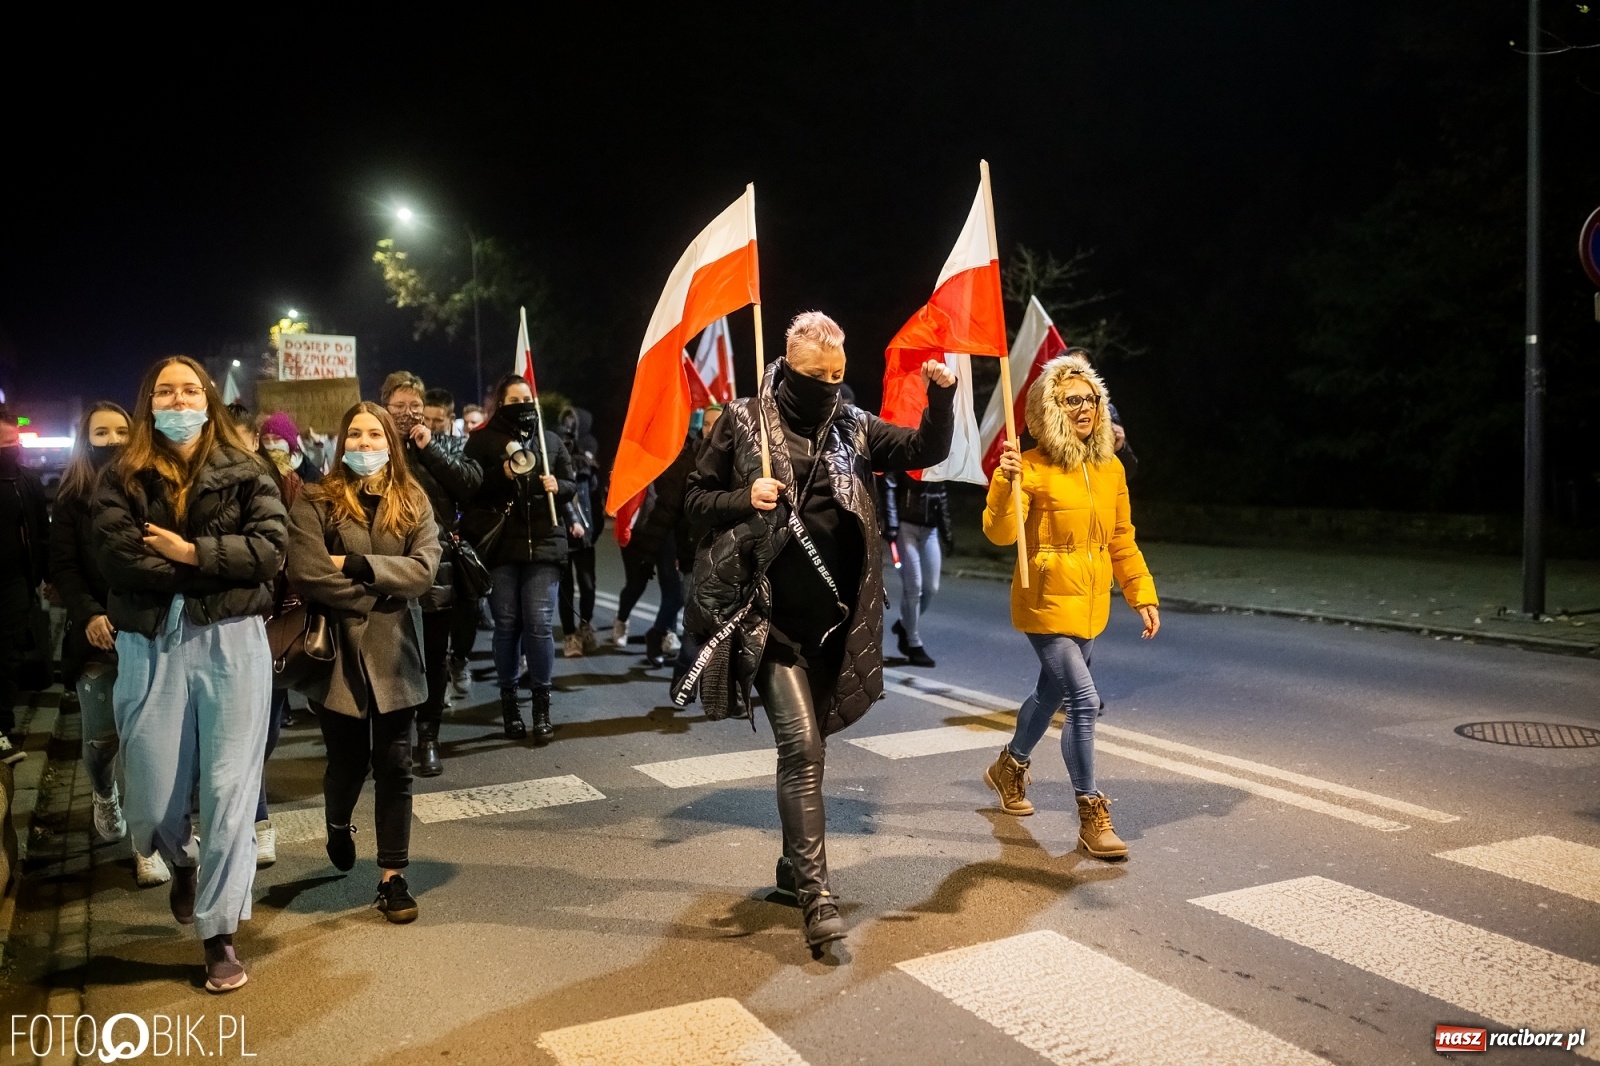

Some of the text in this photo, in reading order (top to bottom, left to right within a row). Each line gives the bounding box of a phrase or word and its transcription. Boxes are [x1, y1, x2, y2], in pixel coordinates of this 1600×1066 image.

[335, 342, 353, 353] DO
[788, 511, 805, 538] IFUL
[800, 536, 817, 557] LIFE
[812, 555, 822, 566] IS
[716, 622, 736, 641] LIFE
[709, 636, 720, 648] IS
[681, 646, 713, 691] BEAUTIFUL
